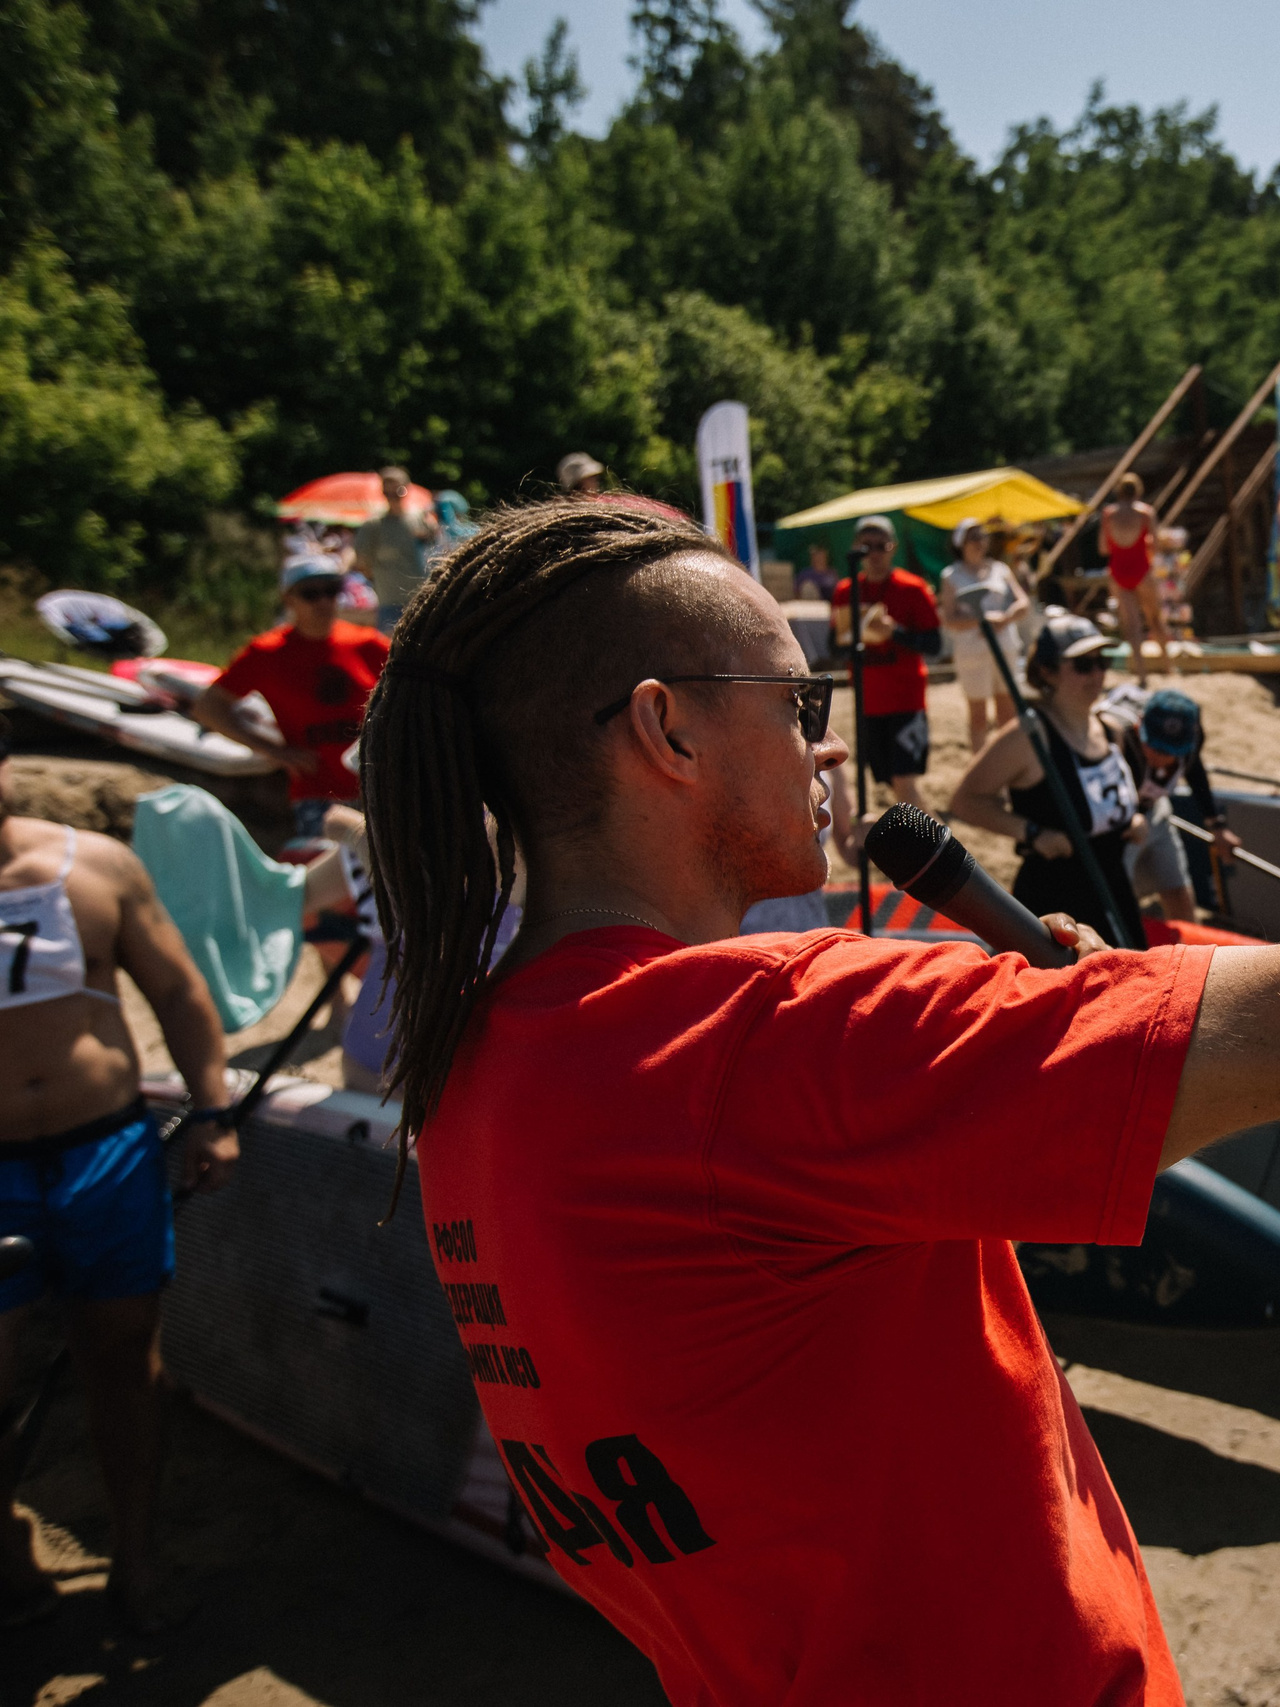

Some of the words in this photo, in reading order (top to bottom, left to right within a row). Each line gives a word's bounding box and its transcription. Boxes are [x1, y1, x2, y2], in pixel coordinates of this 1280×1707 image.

[433, 1219, 478, 1263] РФСОО
[444, 1283, 507, 1331] ДЕРАЦИЯ
[501, 1433, 717, 1568] ДЬЯ
